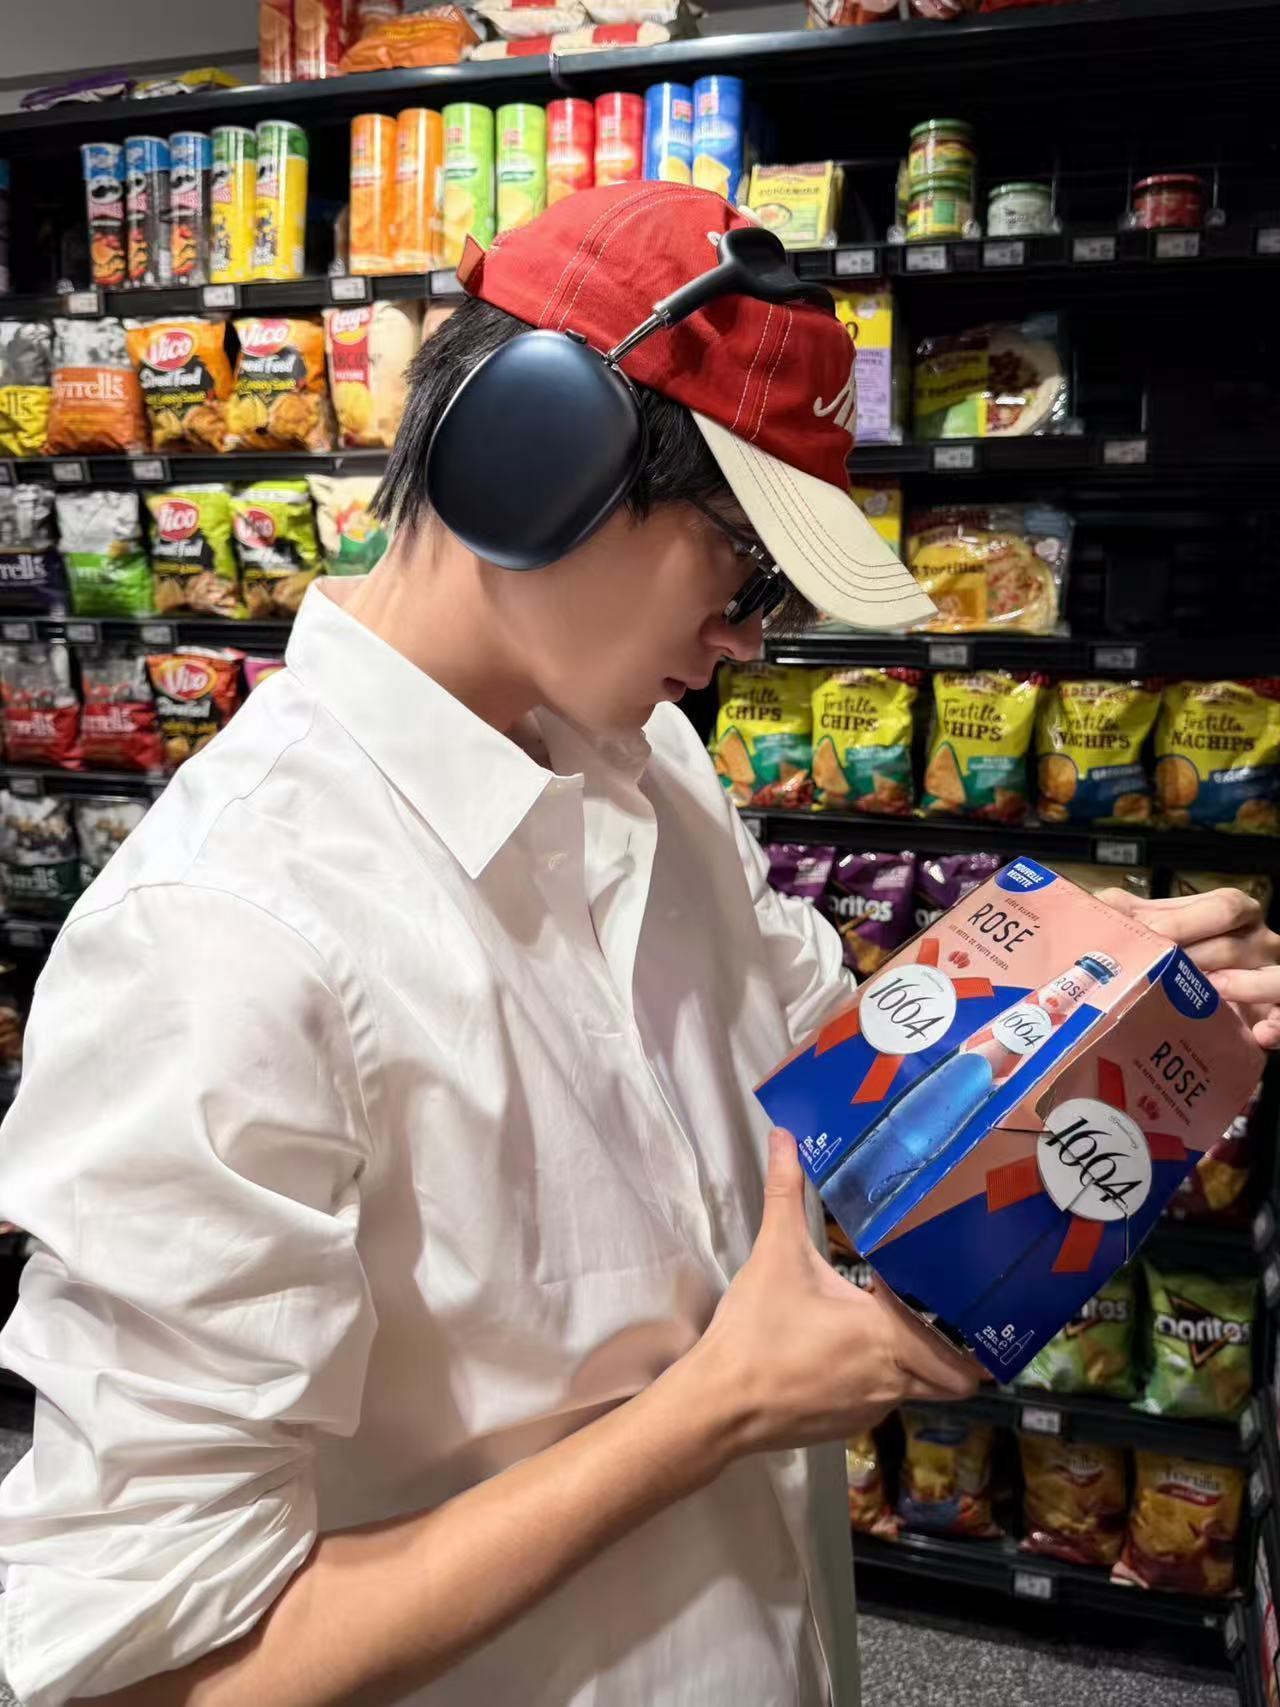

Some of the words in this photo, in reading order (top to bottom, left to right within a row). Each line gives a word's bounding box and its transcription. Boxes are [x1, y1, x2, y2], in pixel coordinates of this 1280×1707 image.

[147, 334, 193, 364] Vico
[725, 704, 783, 722] CHIPS
[821, 692, 880, 714] Tortilla
[942, 698, 1003, 724] Tortilla
[820, 713, 880, 732] CHIPS
[1182, 710, 1246, 733] Tortilla
[1171, 730, 1257, 752] NACHIPS
[1006, 869, 1034, 889] RECETTE
[1013, 862, 1045, 884] NOUVELLE
[967, 902, 1042, 953] ROSÉ
[1055, 976, 1088, 1002] ROSÉ
[1174, 973, 1204, 1010] RECETTE
[1177, 959, 1211, 1003] NOUVELLE
[868, 977, 945, 1040] 1664
[998, 1010, 1047, 1049] 1664
[1149, 1040, 1211, 1109] ROSÉ
[1045, 1116, 1143, 1206] 1664
